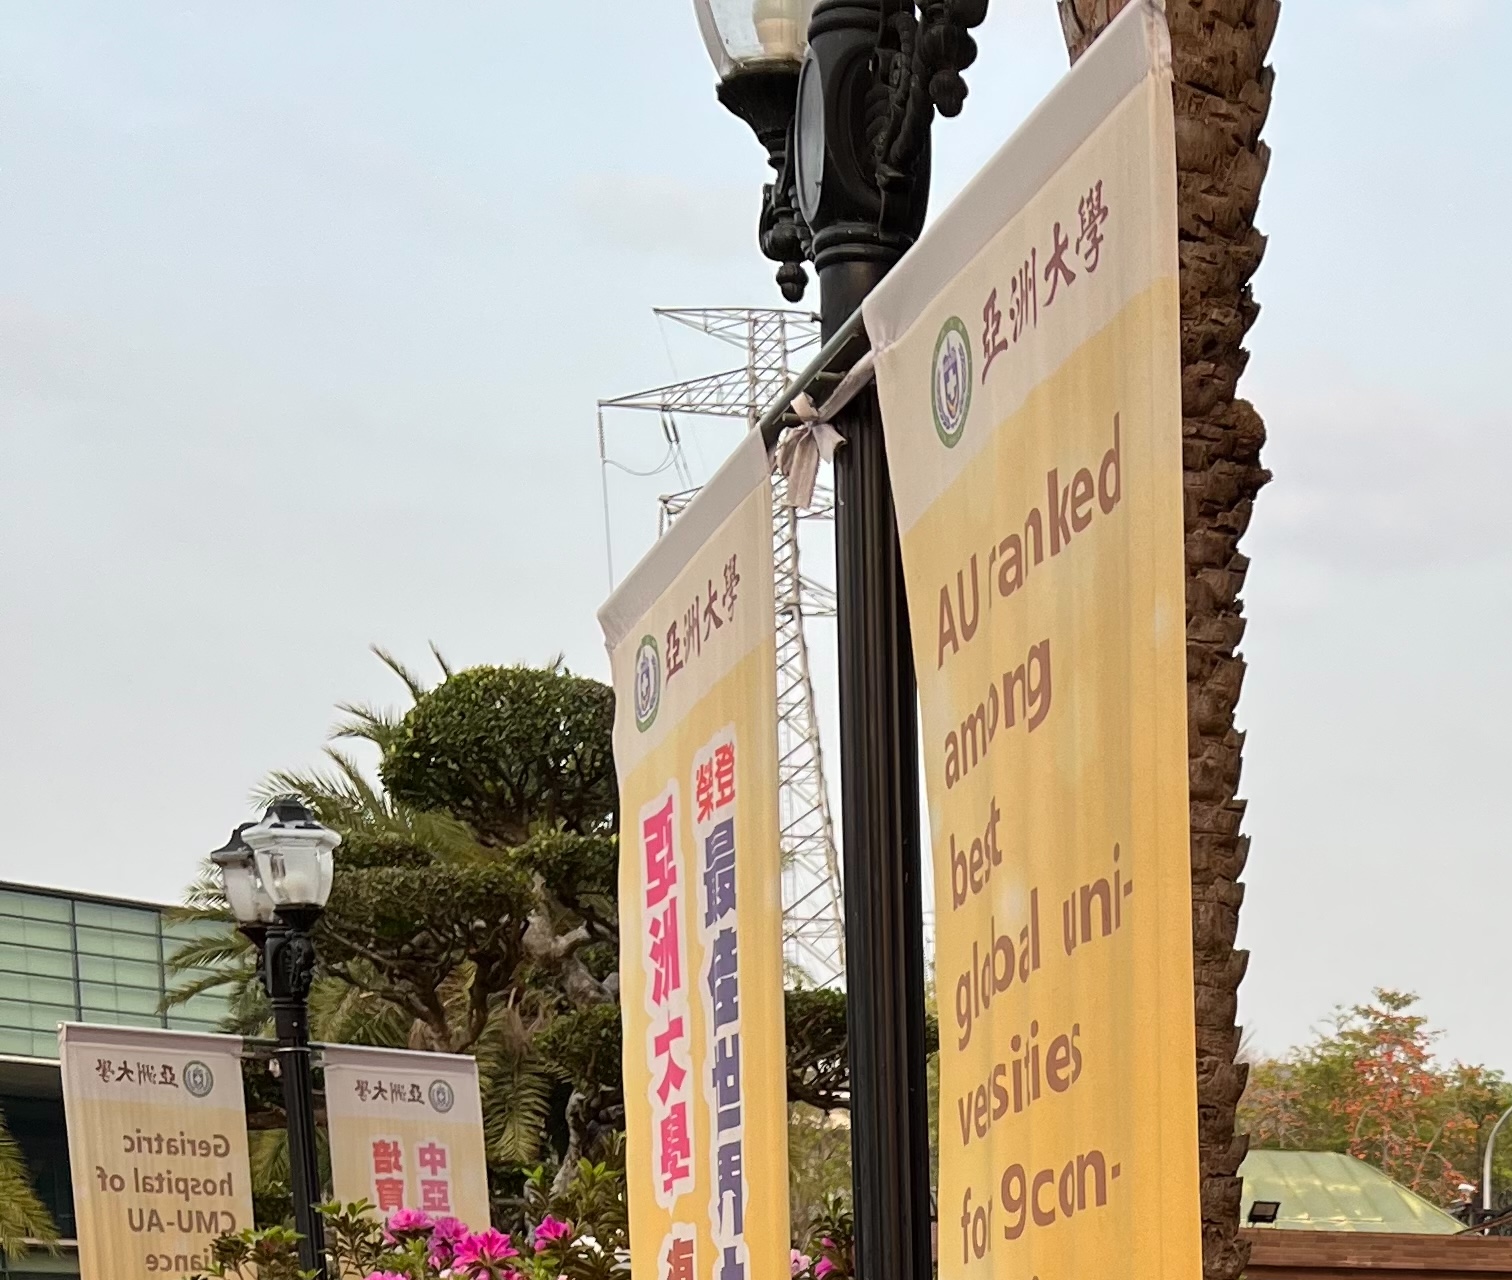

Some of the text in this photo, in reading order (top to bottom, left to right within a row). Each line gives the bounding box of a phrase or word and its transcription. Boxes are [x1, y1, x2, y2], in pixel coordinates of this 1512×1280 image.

[981, 180, 1109, 386] 亞洲大學
[938, 411, 1122, 671] AU ranked
[665, 554, 740, 687] 亞洲大學
[945, 638, 1052, 790] among
[950, 796, 1003, 912] best
[956, 843, 1133, 1052] global uni-
[961, 1186, 993, 1265] for
